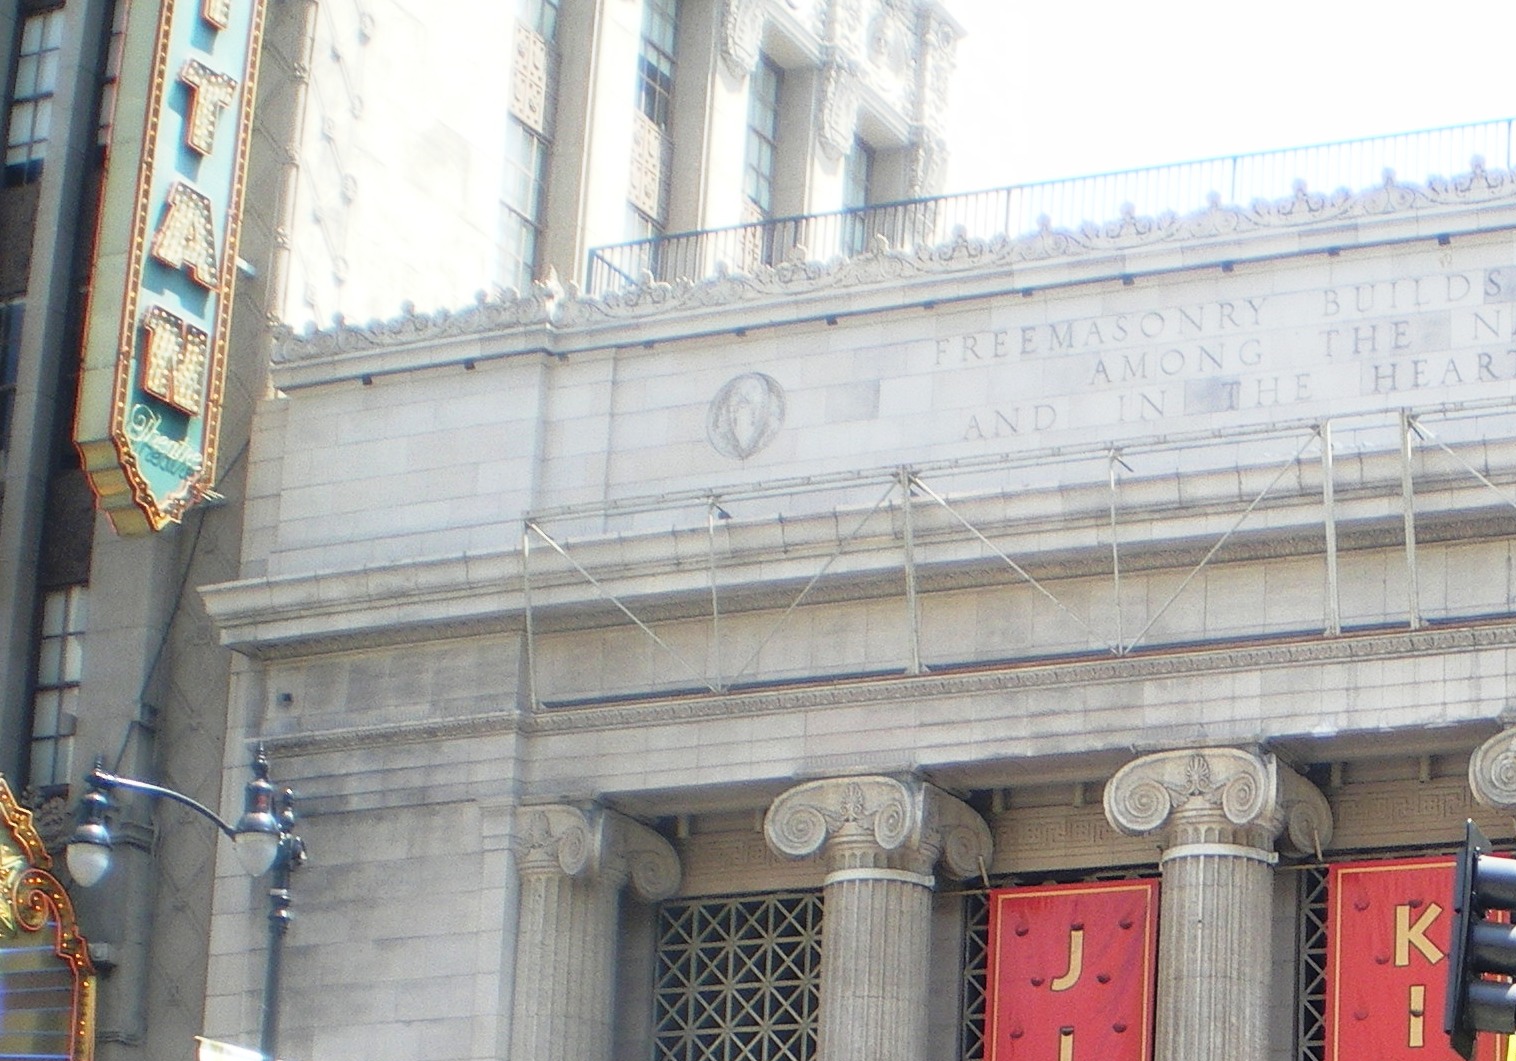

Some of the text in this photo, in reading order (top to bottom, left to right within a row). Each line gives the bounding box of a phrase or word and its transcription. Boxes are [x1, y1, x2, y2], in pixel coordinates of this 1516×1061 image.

[934, 297, 1268, 366] FREEMASONRY
[1322, 269, 1502, 318] BUILDS
[1088, 338, 1264, 387] AMONG
[1318, 320, 1412, 357] THE
[962, 404, 1058, 443] AND
[1117, 390, 1168, 423] IN
[1221, 373, 1312, 412] THE
